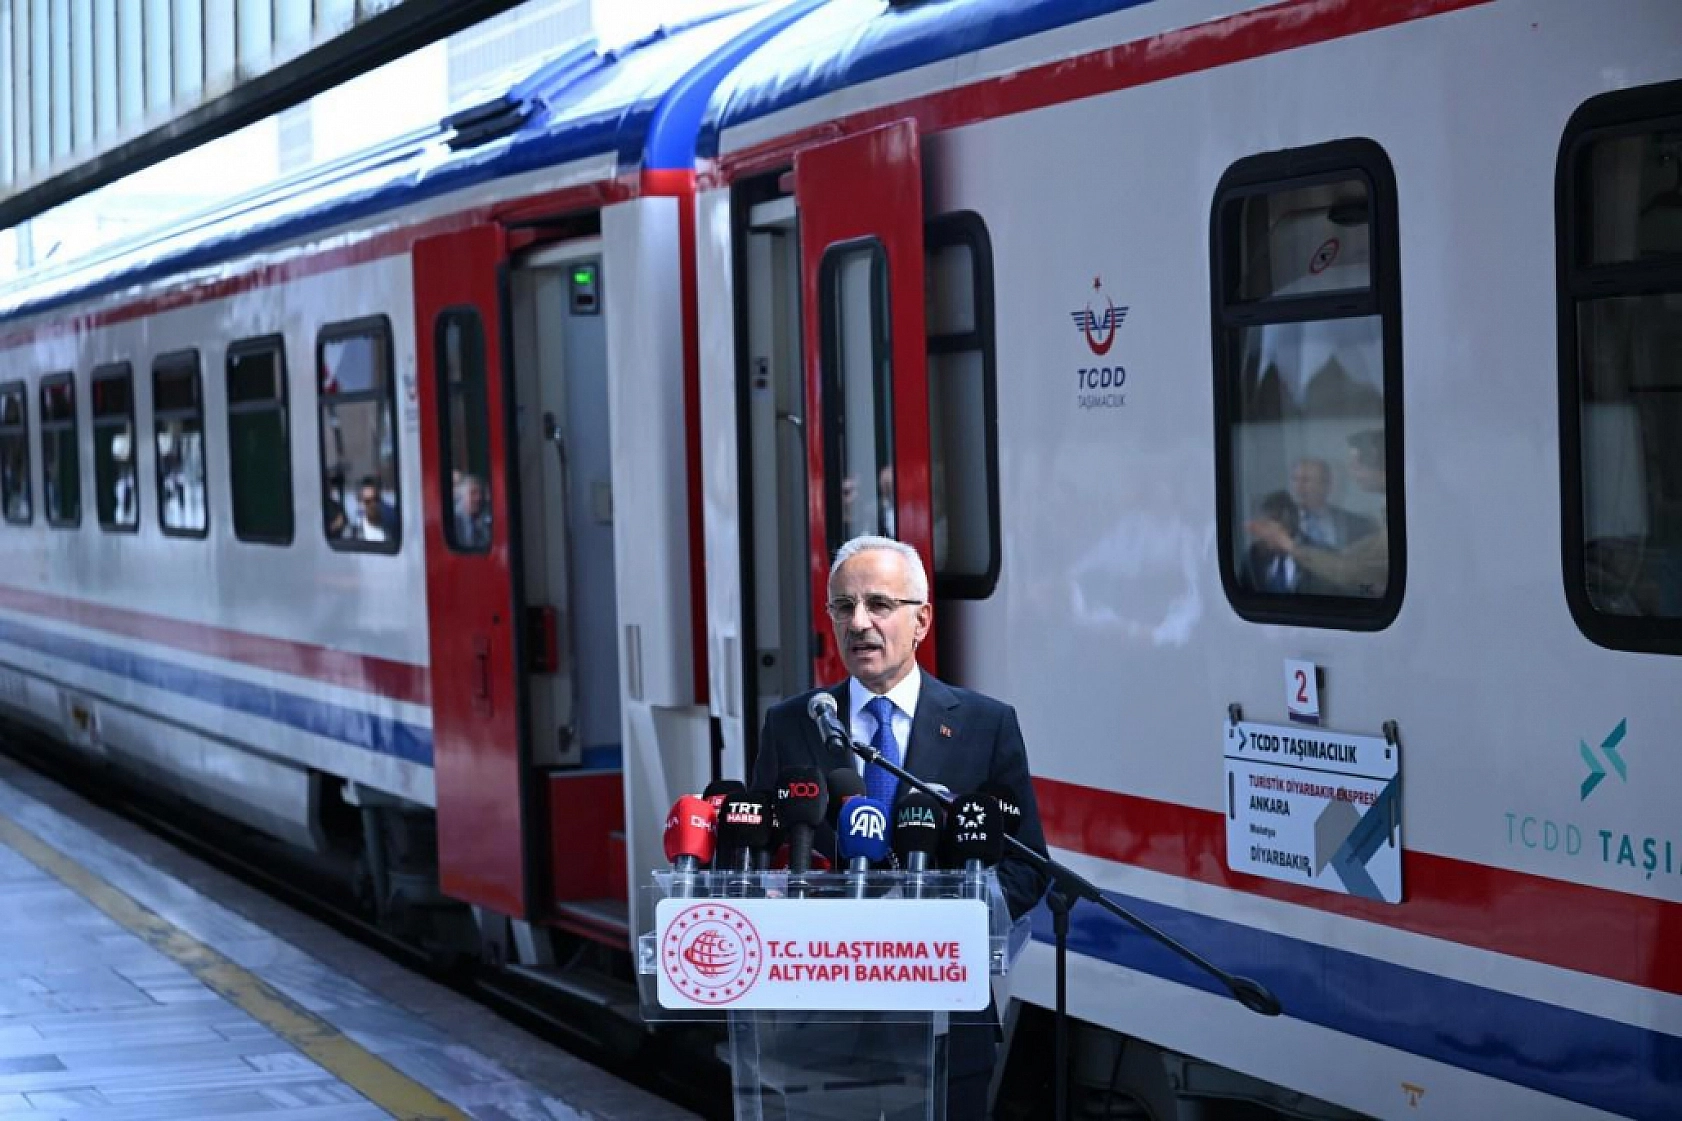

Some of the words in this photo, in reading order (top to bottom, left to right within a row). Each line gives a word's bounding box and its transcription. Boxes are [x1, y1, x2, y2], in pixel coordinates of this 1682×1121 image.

[1077, 366, 1126, 390] TCDD
[1295, 669, 1309, 704] 2
[1250, 732, 1279, 753] TCDD
[1282, 737, 1357, 763] TAŞIMACILIK
[729, 801, 763, 815] TRT
[898, 806, 935, 822] MHA
[1249, 795, 1290, 816] ANKARA
[726, 813, 763, 824] HABER
[957, 832, 987, 842] STAR
[1504, 812, 1582, 856] TCDD
[1598, 829, 1682, 881] TAŞI
[1251, 843, 1311, 872] DİYARBAKIR
[767, 940, 802, 959] T.C.
[809, 940, 929, 963] ULAŞTIRMA
[934, 941, 960, 959] VE
[767, 964, 849, 982] ALTYAPI
[854, 962, 967, 983] BAKANLIĞI
